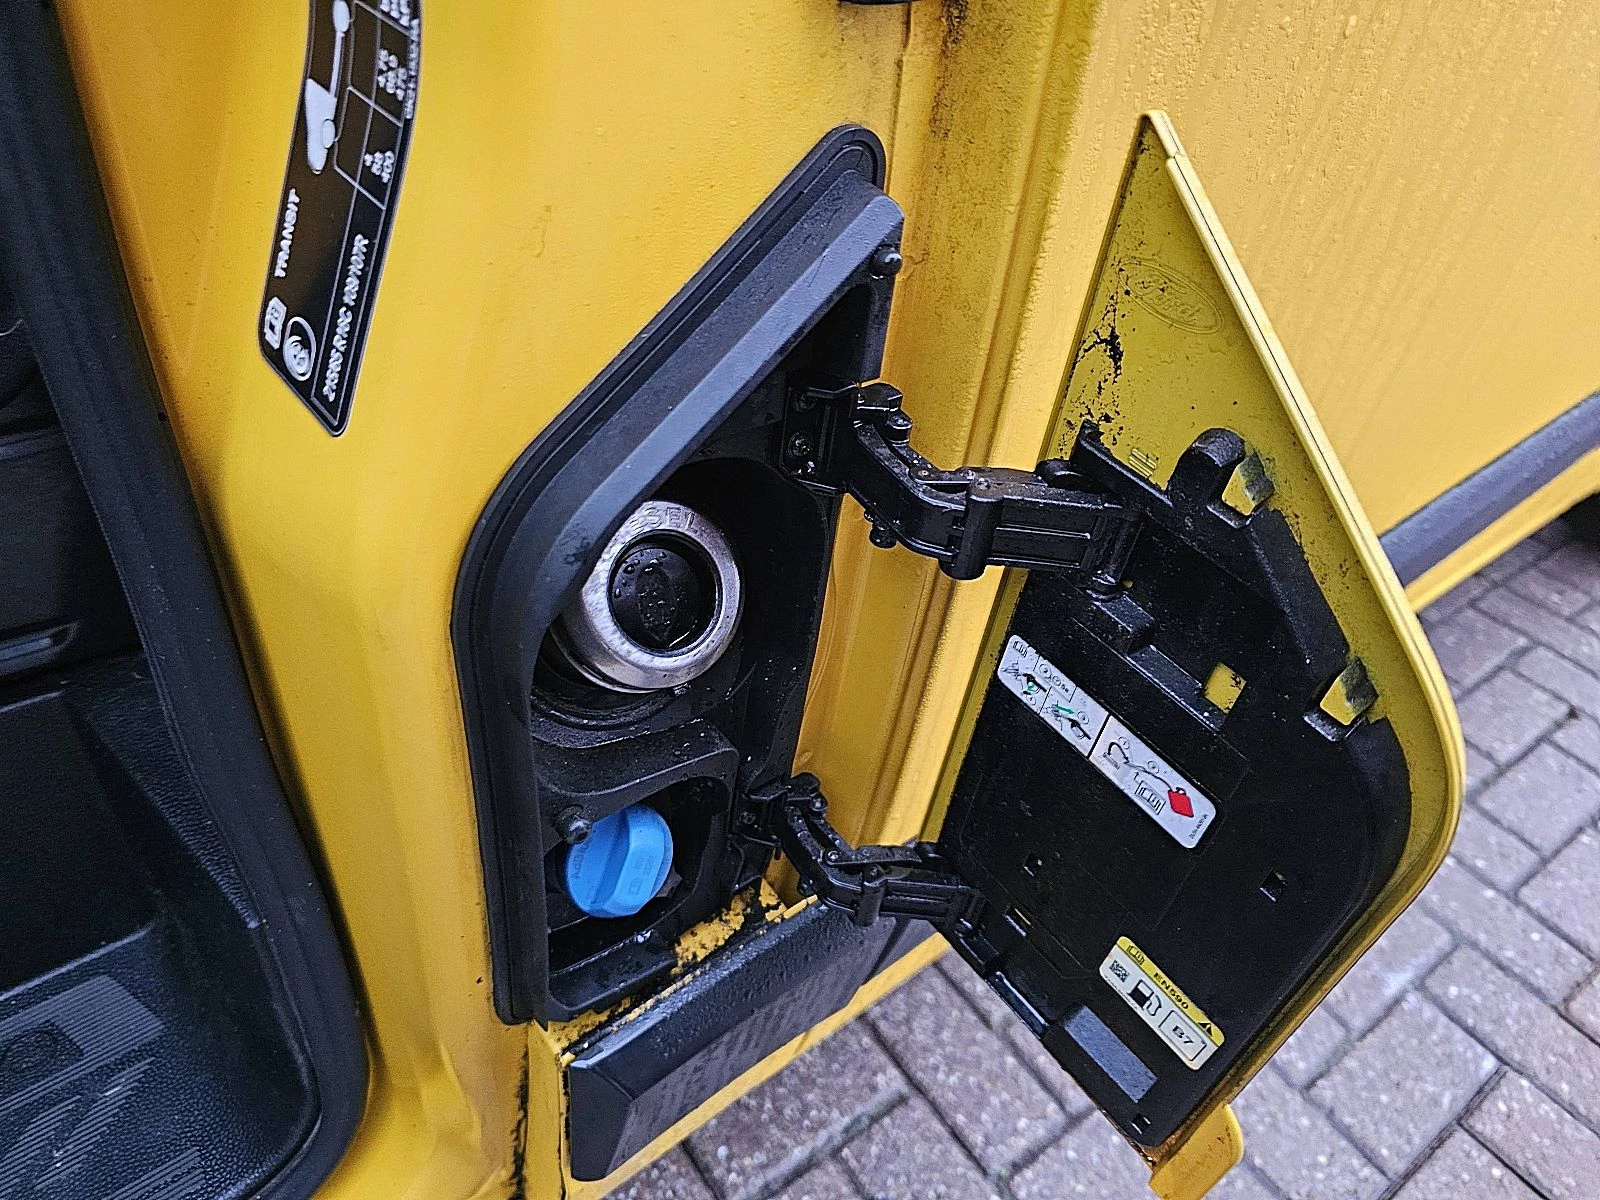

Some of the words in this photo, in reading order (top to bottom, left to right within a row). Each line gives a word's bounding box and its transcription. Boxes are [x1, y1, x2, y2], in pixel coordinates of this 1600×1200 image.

[274, 188, 300, 277] TRANSIT
[1153, 971, 1189, 1010] EN590
[1172, 1025, 1195, 1045] B7
